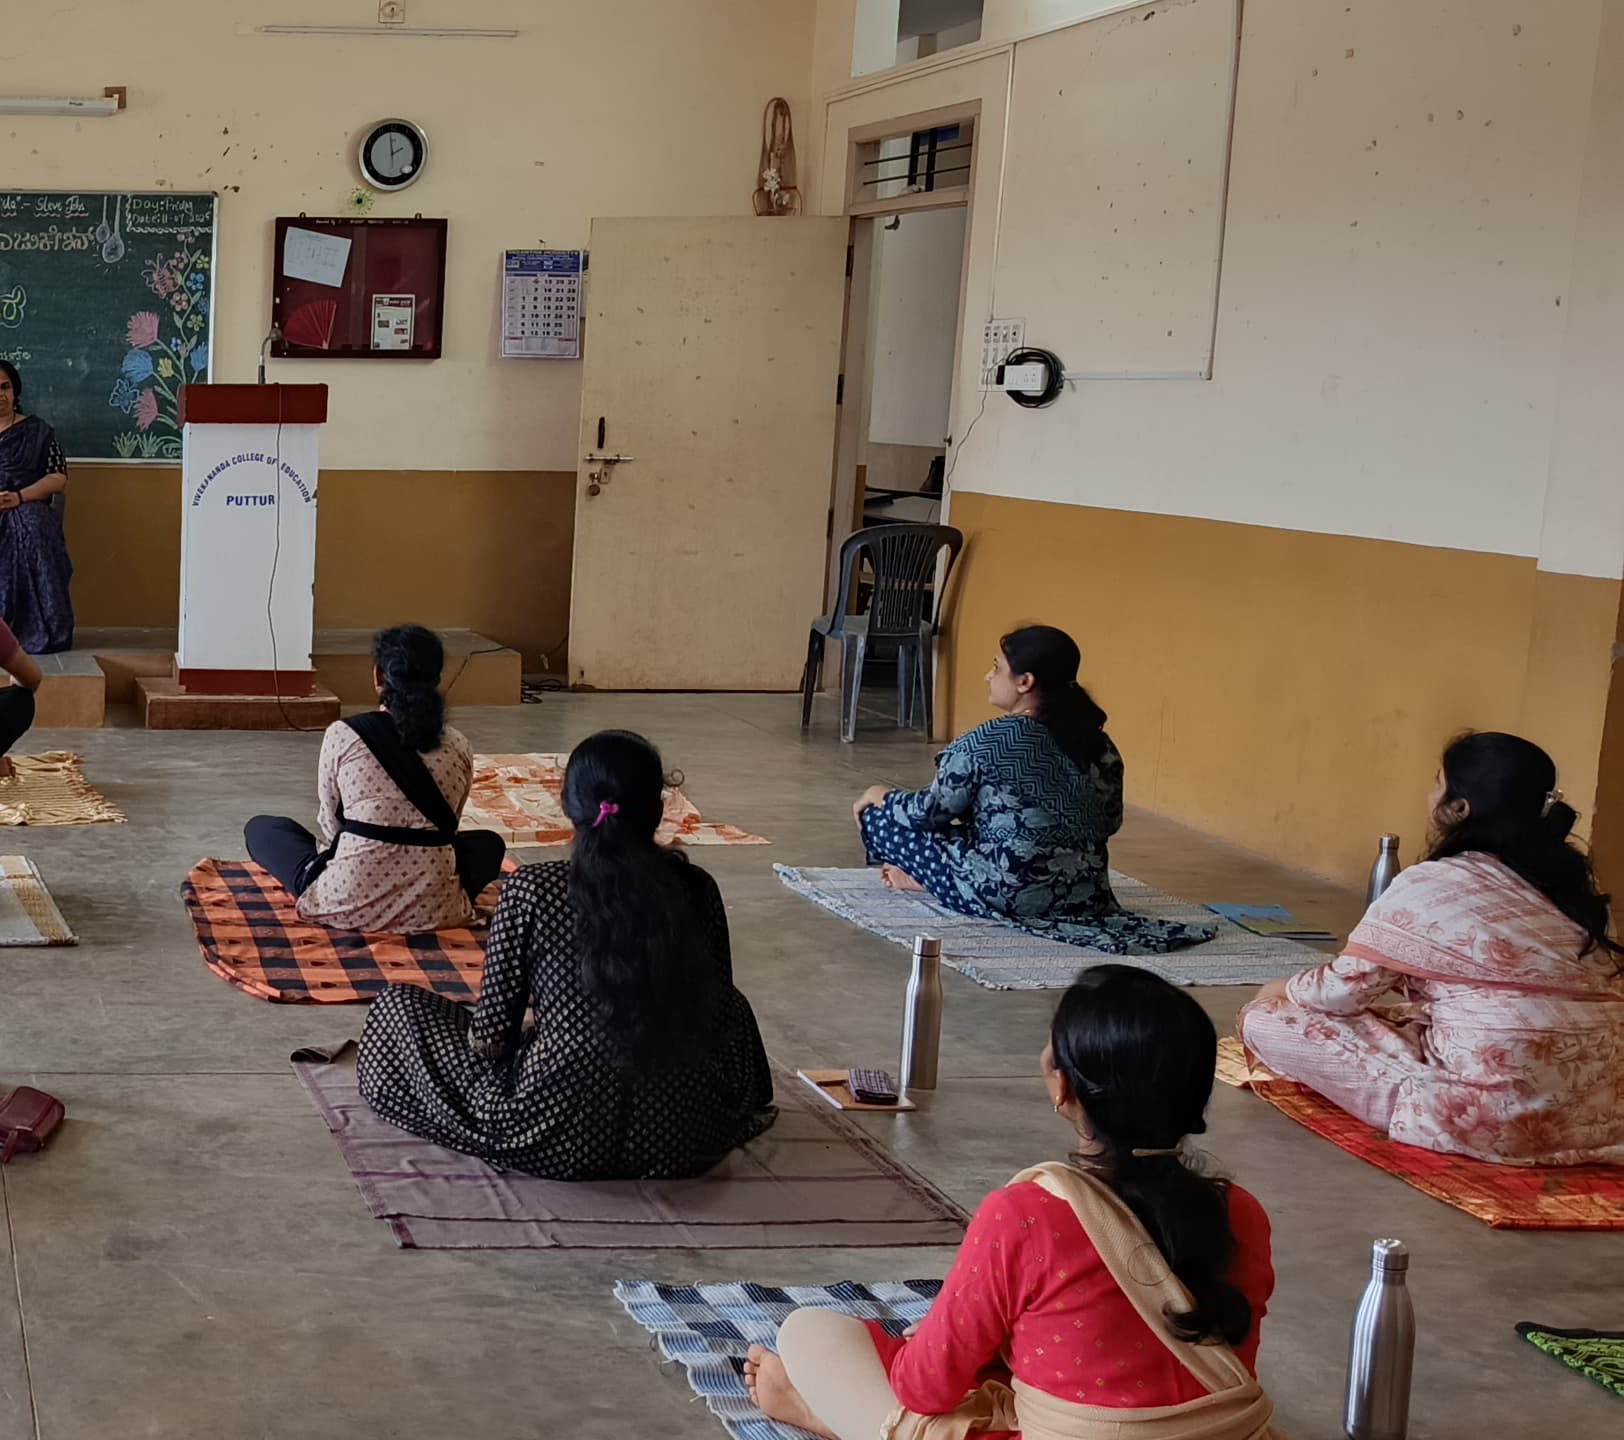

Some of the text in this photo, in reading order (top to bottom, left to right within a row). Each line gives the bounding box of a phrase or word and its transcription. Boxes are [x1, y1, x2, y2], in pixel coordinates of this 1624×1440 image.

[34, 195, 63, 212] Steve
[192, 452, 312, 507] VIVEKANANDA COLLEGE OF EDUCATION
[226, 494, 276, 506] PUTTUR
